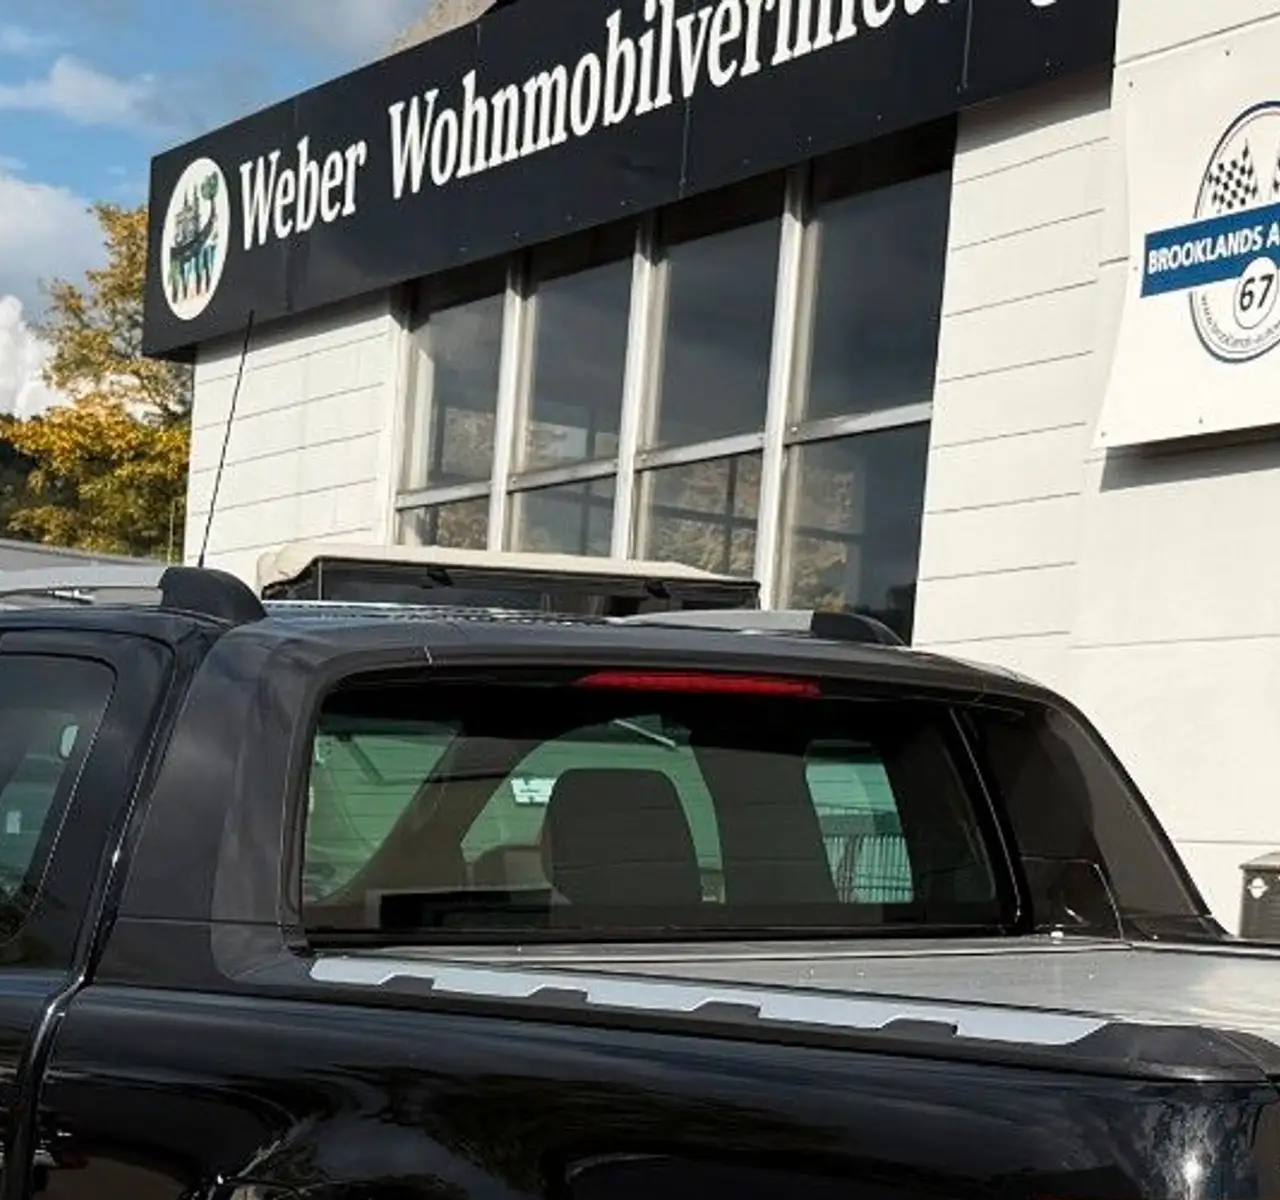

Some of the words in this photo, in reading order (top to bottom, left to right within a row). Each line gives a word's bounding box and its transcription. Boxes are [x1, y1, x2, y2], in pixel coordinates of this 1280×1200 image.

[239, 135, 368, 251] Weber
[1147, 226, 1264, 274] BROOKLANDS
[1238, 273, 1275, 312] 67
